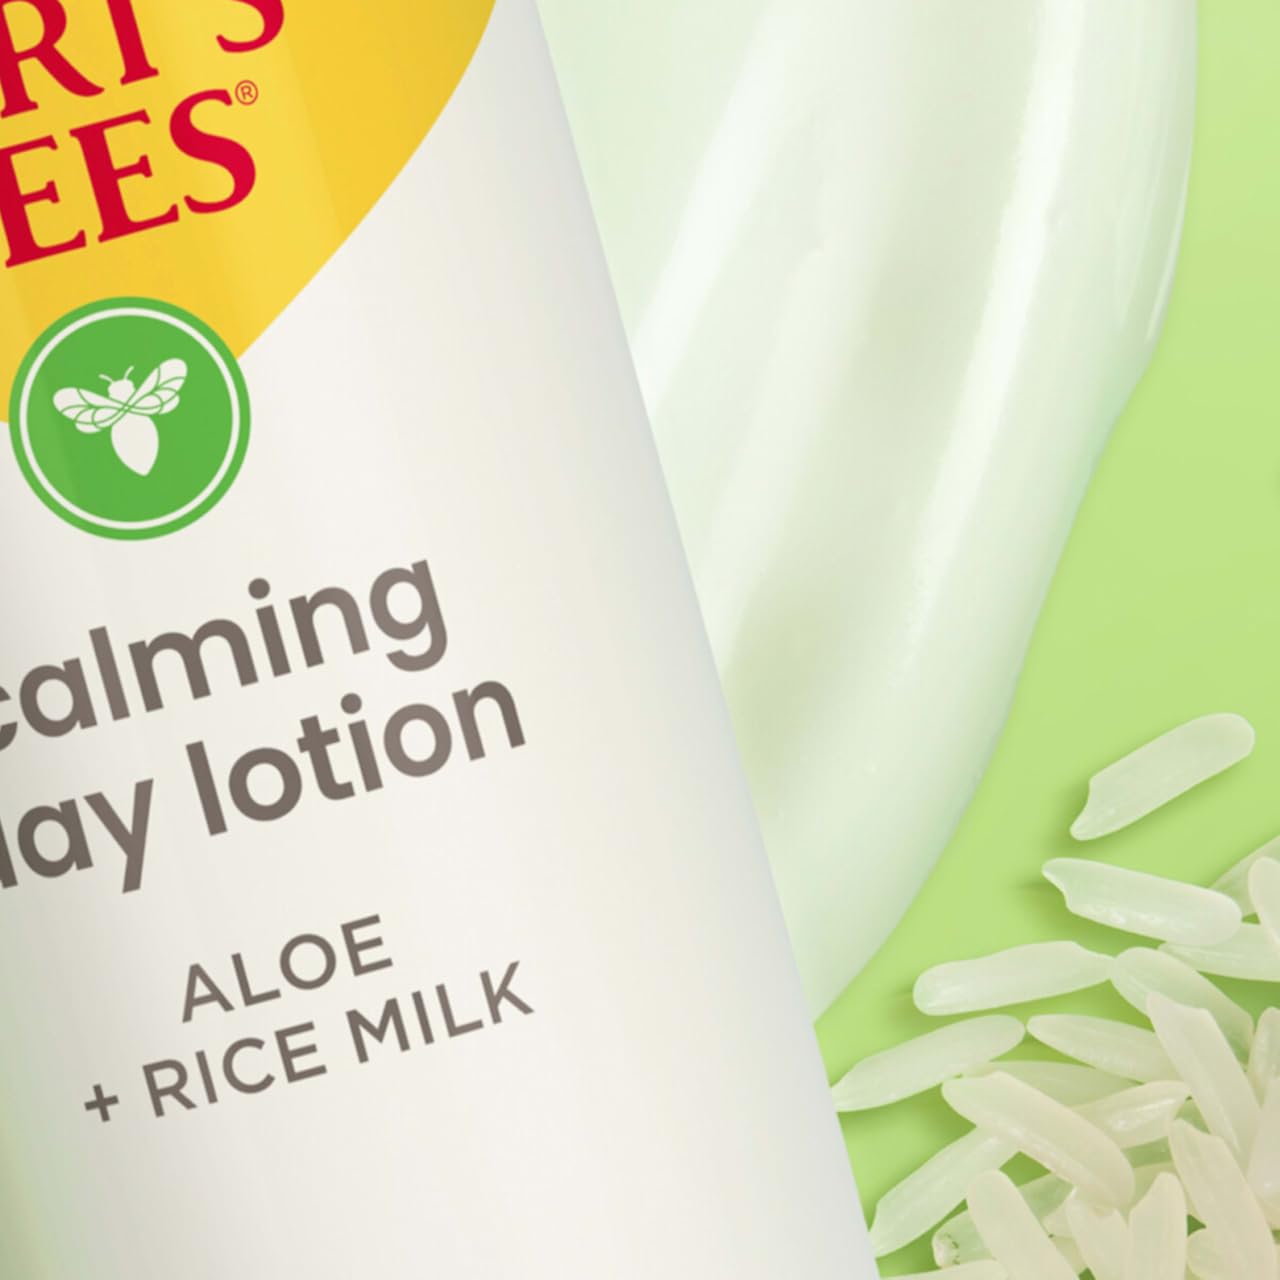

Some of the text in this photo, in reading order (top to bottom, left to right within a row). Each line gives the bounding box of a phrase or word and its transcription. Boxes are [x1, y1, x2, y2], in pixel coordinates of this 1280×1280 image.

[185, 680, 526, 837] lotion
[83, 961, 535, 1123] + RICE MILK
[181, 913, 394, 1024] ALOE
